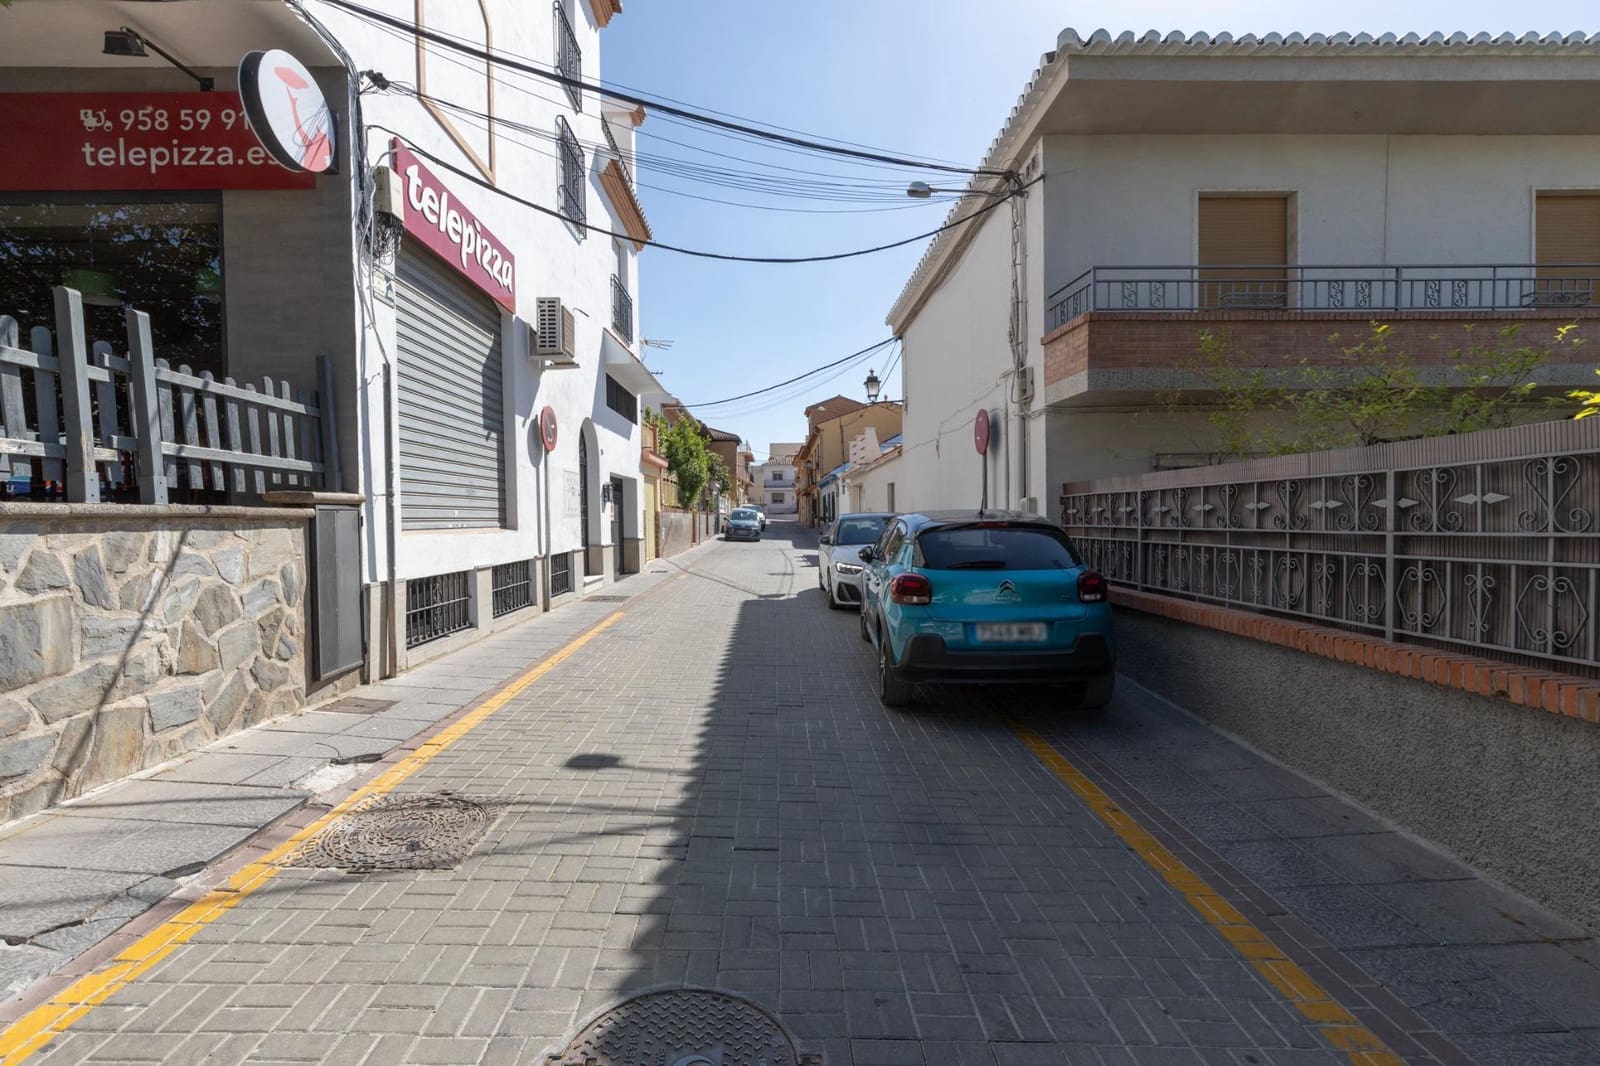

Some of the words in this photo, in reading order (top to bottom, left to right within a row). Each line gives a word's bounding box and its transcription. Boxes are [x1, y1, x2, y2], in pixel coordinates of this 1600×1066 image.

[120, 109, 169, 131] 958
[180, 109, 211, 131] 59
[405, 164, 513, 293] telepizza
